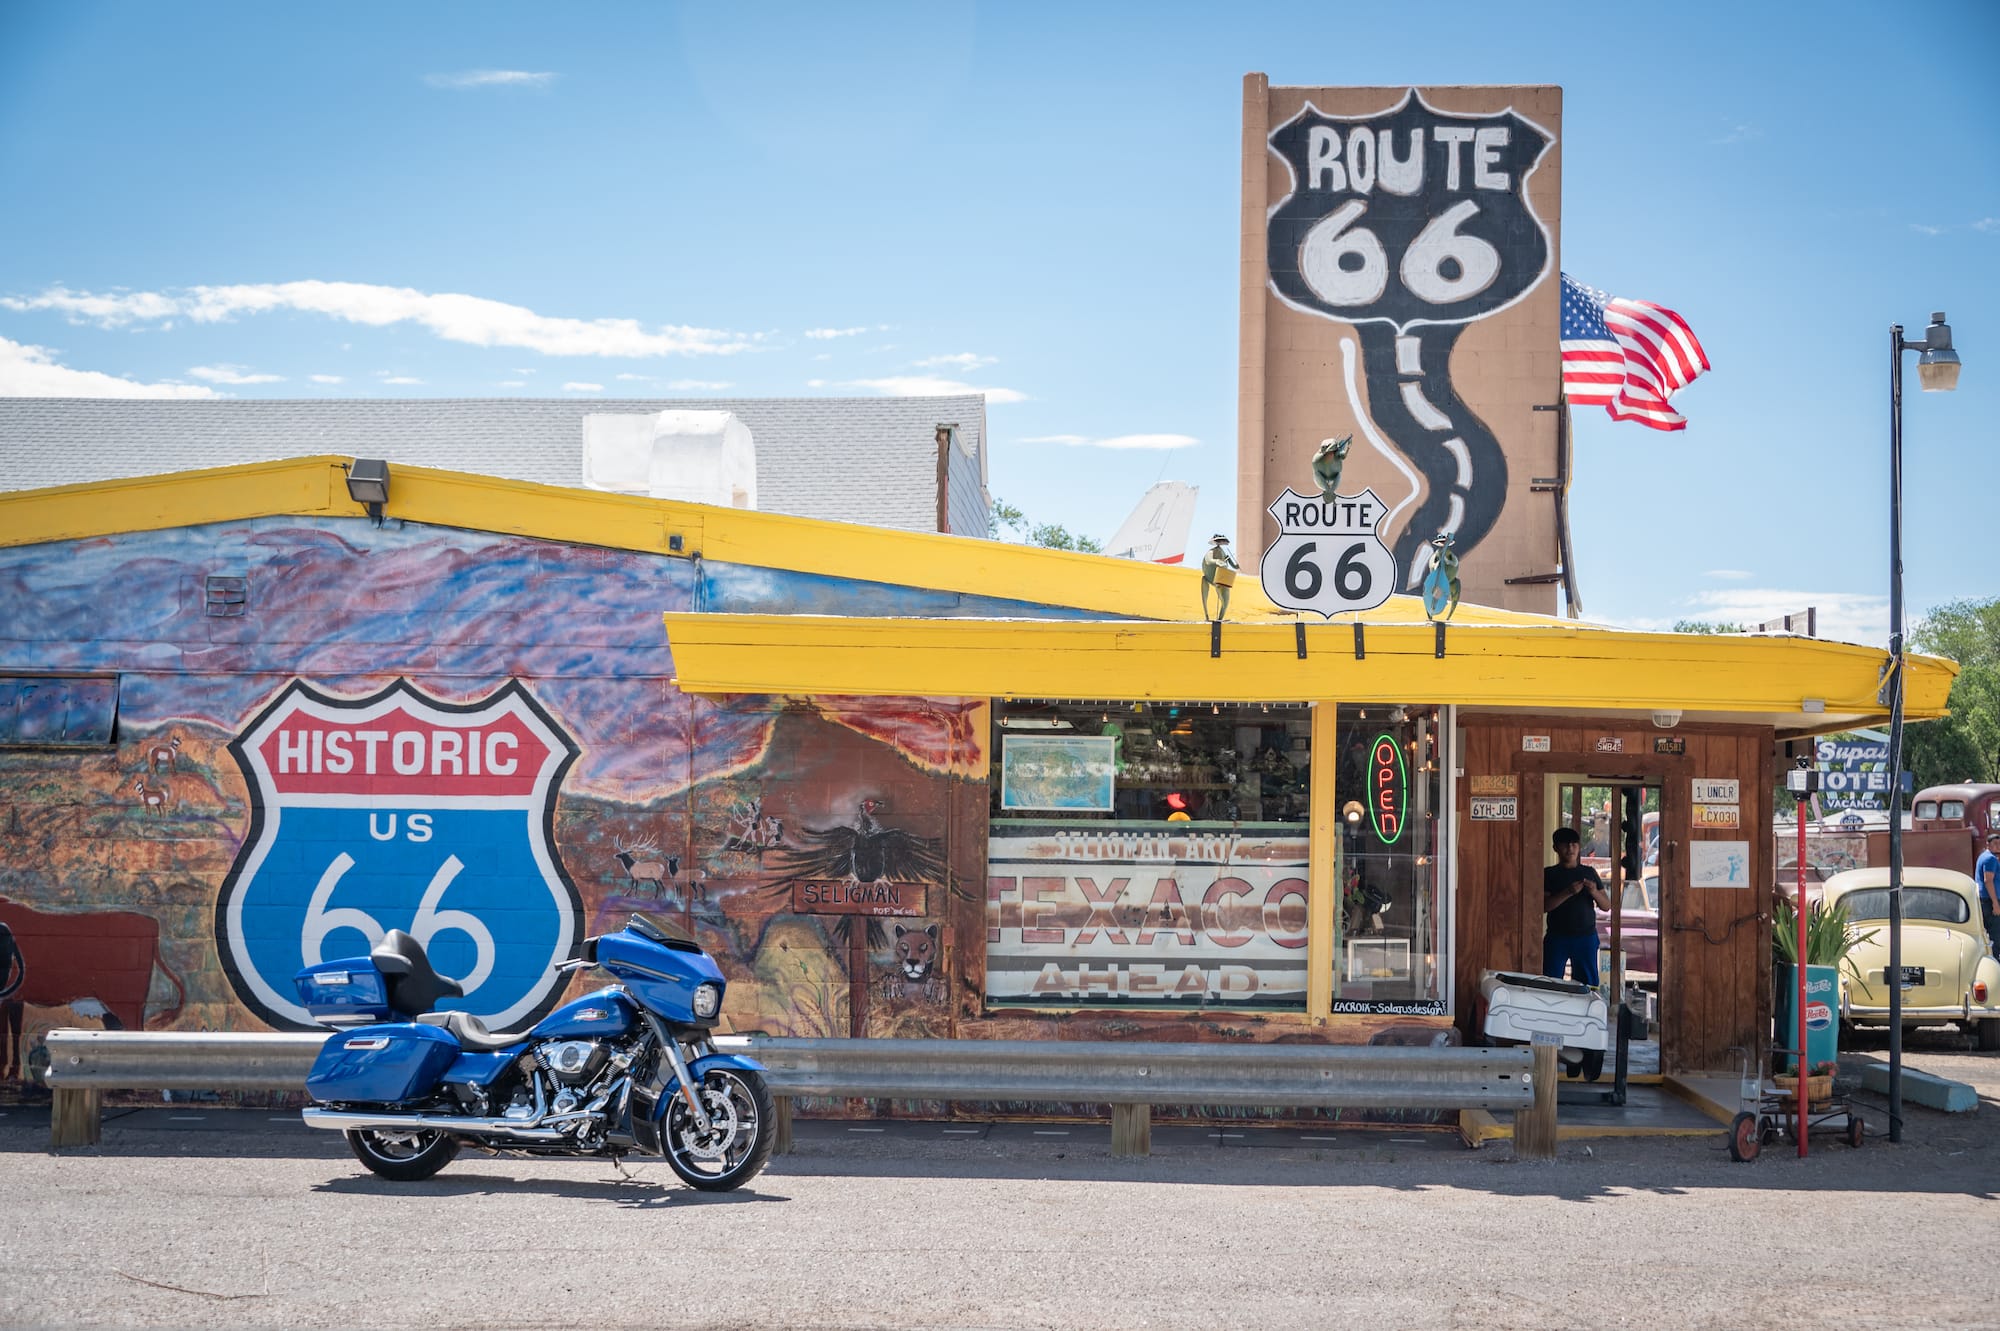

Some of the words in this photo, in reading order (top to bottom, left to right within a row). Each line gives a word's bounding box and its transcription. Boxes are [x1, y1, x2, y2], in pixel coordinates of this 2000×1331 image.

[1309, 125, 1511, 196] ROUTE
[1300, 199, 1501, 306] 66
[1286, 502, 1372, 528] ROUTE
[1284, 541, 1372, 600] 66
[278, 729, 519, 776] HISTORIC
[1816, 741, 1889, 768] Supai
[1376, 743, 1398, 834] OPEN
[1817, 771, 1905, 791] OTE
[1827, 800, 1880, 809] VACANCY
[369, 813, 434, 842] US
[804, 883, 899, 905] SELIGMAN
[987, 876, 1309, 949] TEXACO
[302, 851, 495, 998] 66
[1030, 963, 1259, 1000] AHEAD
